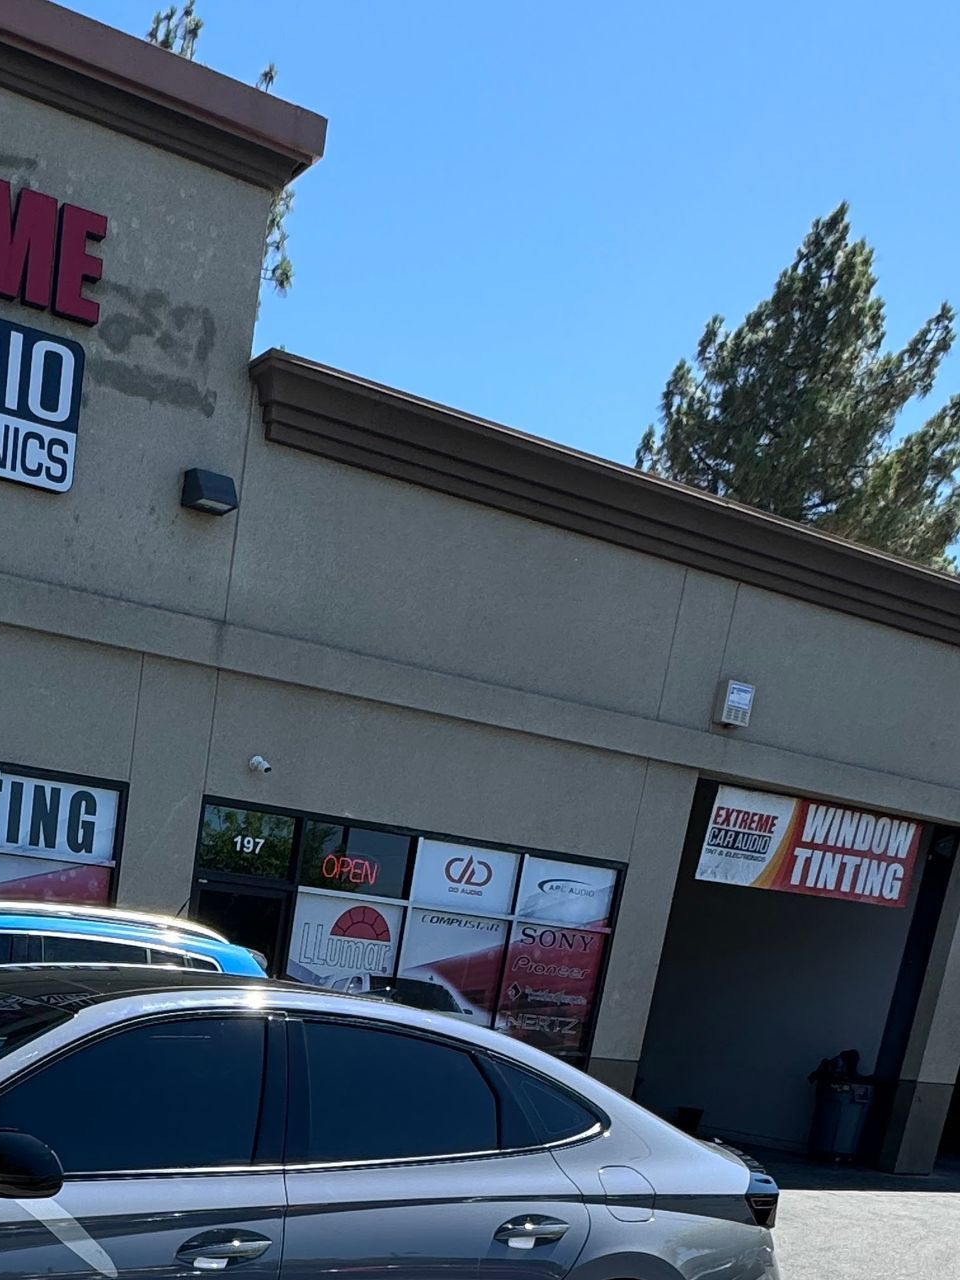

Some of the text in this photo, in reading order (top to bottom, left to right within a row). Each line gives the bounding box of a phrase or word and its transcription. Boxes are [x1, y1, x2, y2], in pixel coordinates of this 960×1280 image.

[712, 806, 779, 834] EXTREME
[801, 803, 917, 859] WINDOW
[233, 835, 265, 855] 197
[708, 828, 771, 853] CAR AUDIO
[322, 854, 379, 885] OPEN
[790, 847, 905, 901] TINTING
[460, 887, 483, 897] AUDIO
[548, 883, 596, 897] ARC AUDIO
[520, 926, 594, 952] SONY
[512, 954, 591, 979] Pioneer
